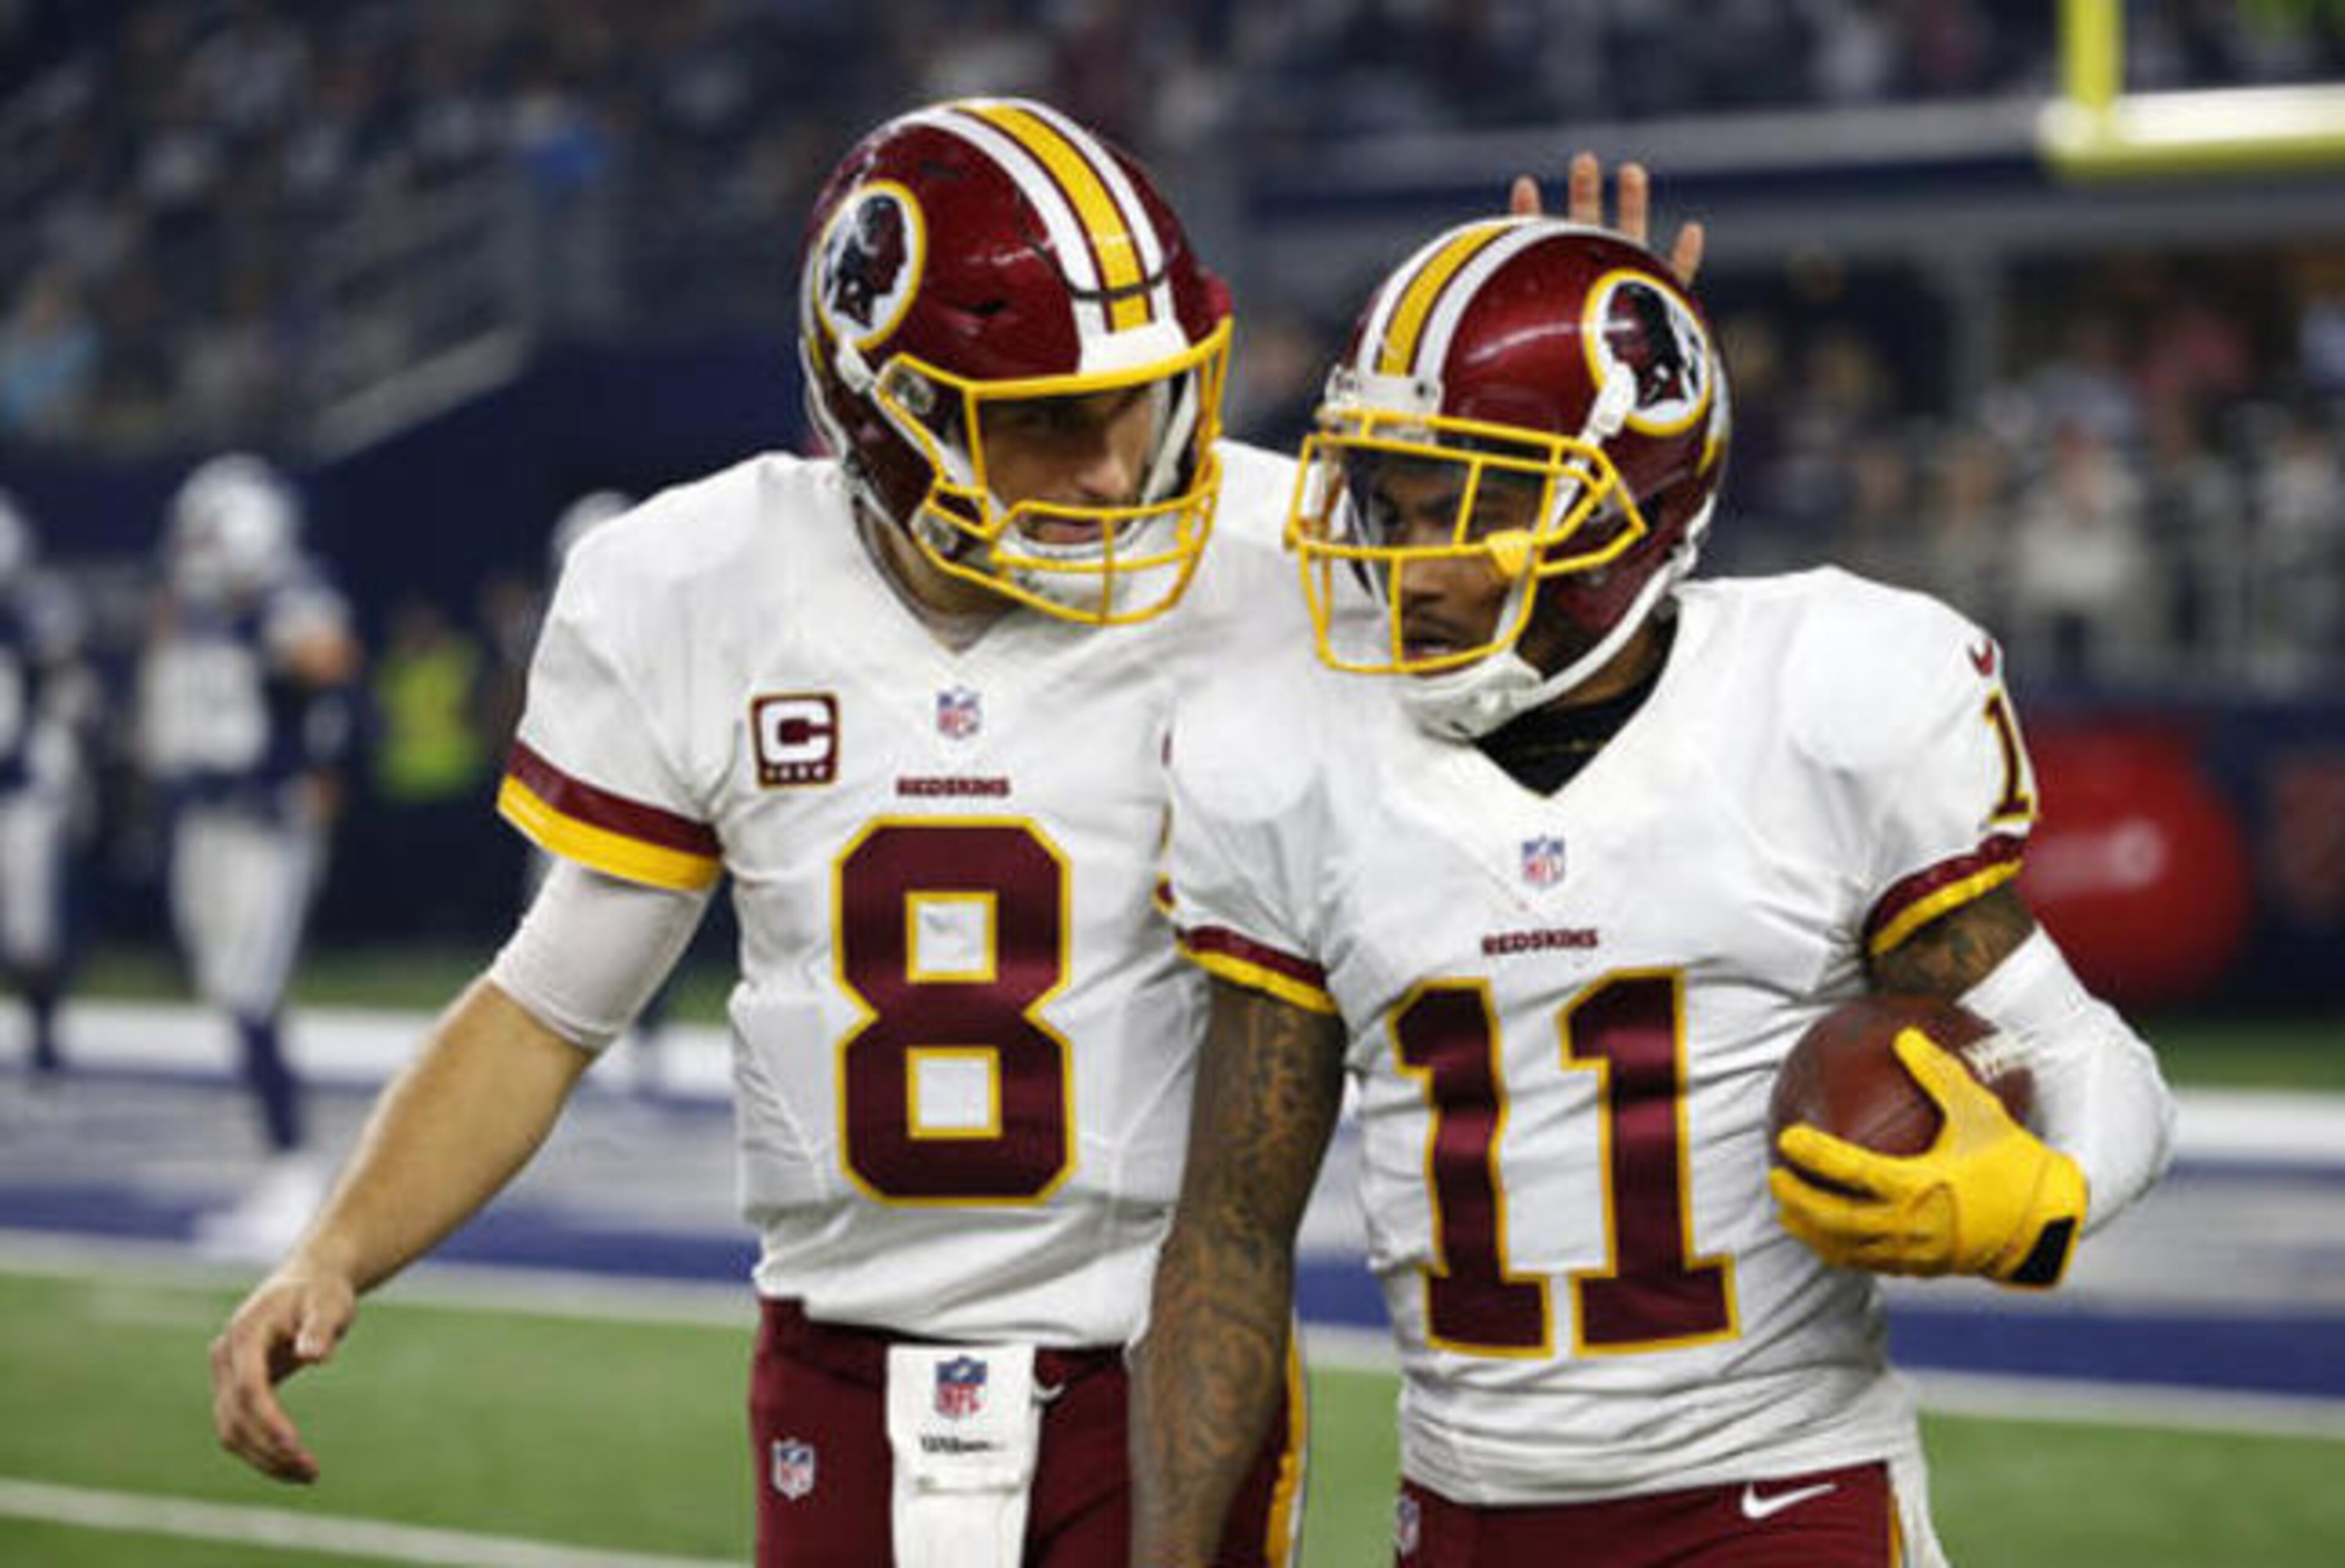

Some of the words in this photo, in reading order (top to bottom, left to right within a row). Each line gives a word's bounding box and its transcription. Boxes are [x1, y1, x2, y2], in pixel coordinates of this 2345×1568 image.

[757, 698, 831, 766] C
[896, 778, 1010, 796] REDSKINS
[1481, 926, 1598, 955] REDSKINS
[831, 813, 1076, 1207] 8
[1387, 966, 1742, 1359] 11
